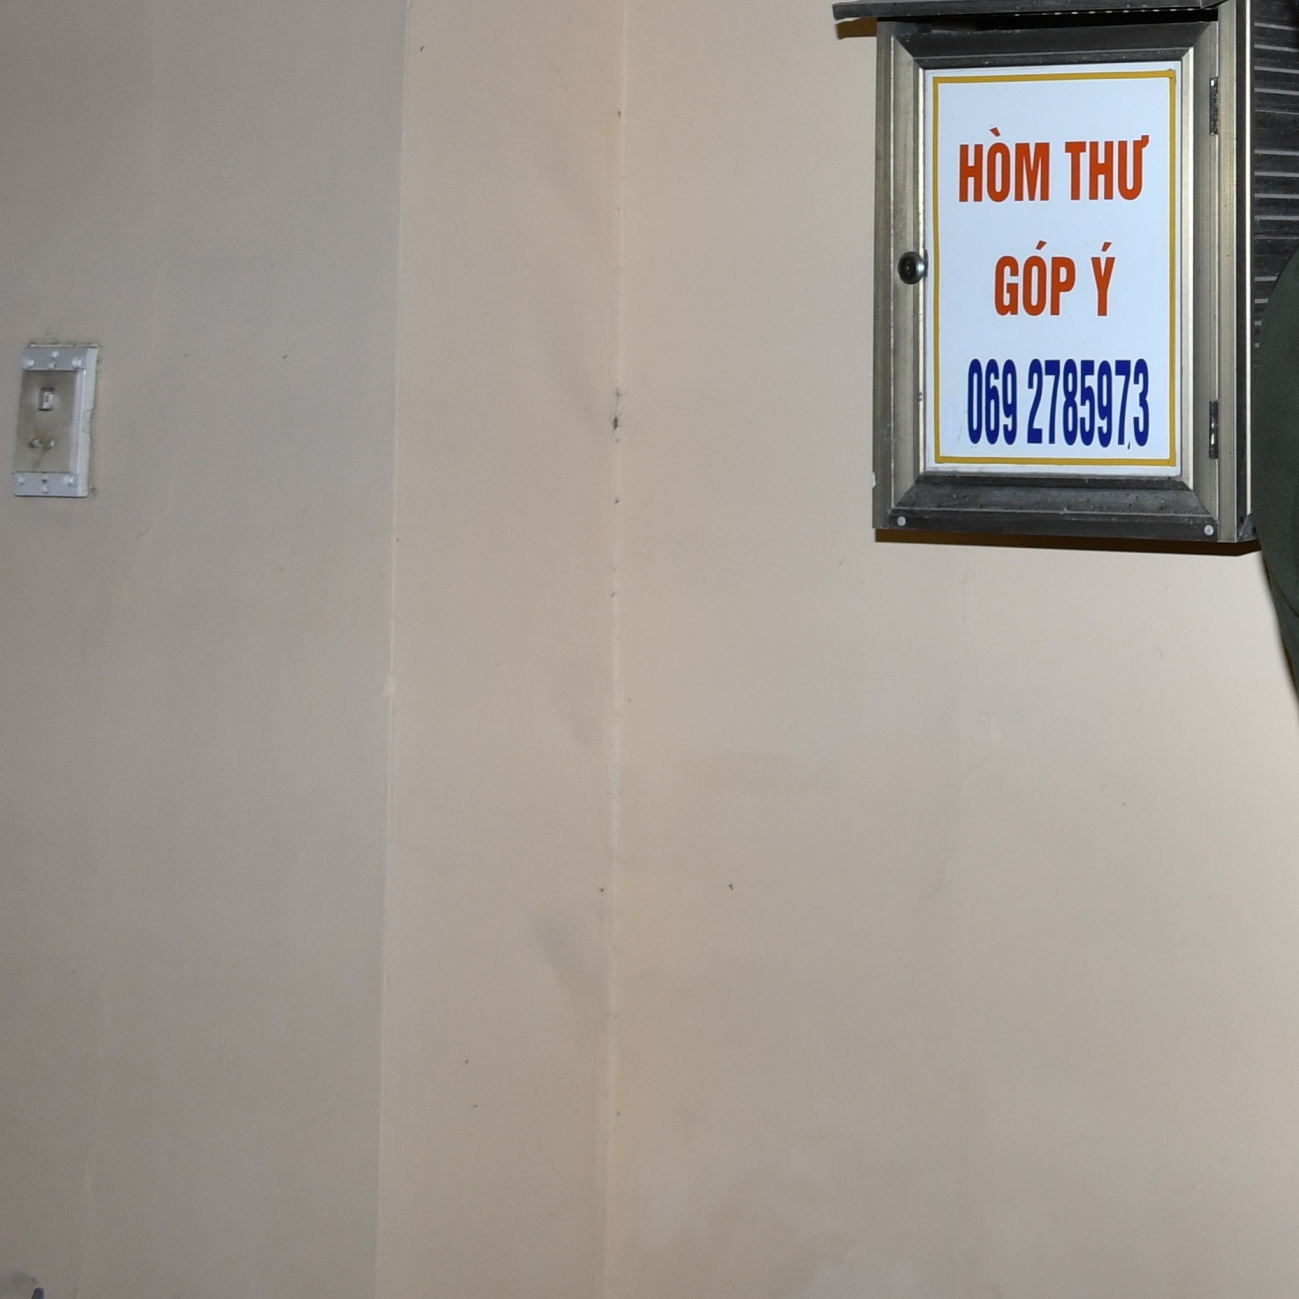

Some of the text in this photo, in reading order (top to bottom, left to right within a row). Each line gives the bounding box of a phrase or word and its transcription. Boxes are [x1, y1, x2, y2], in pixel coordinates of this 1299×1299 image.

[958, 127, 1150, 202] HÒM THƯ
[994, 240, 1116, 317] GÓP Ý
[967, 358, 1150, 448] 069 2785973
